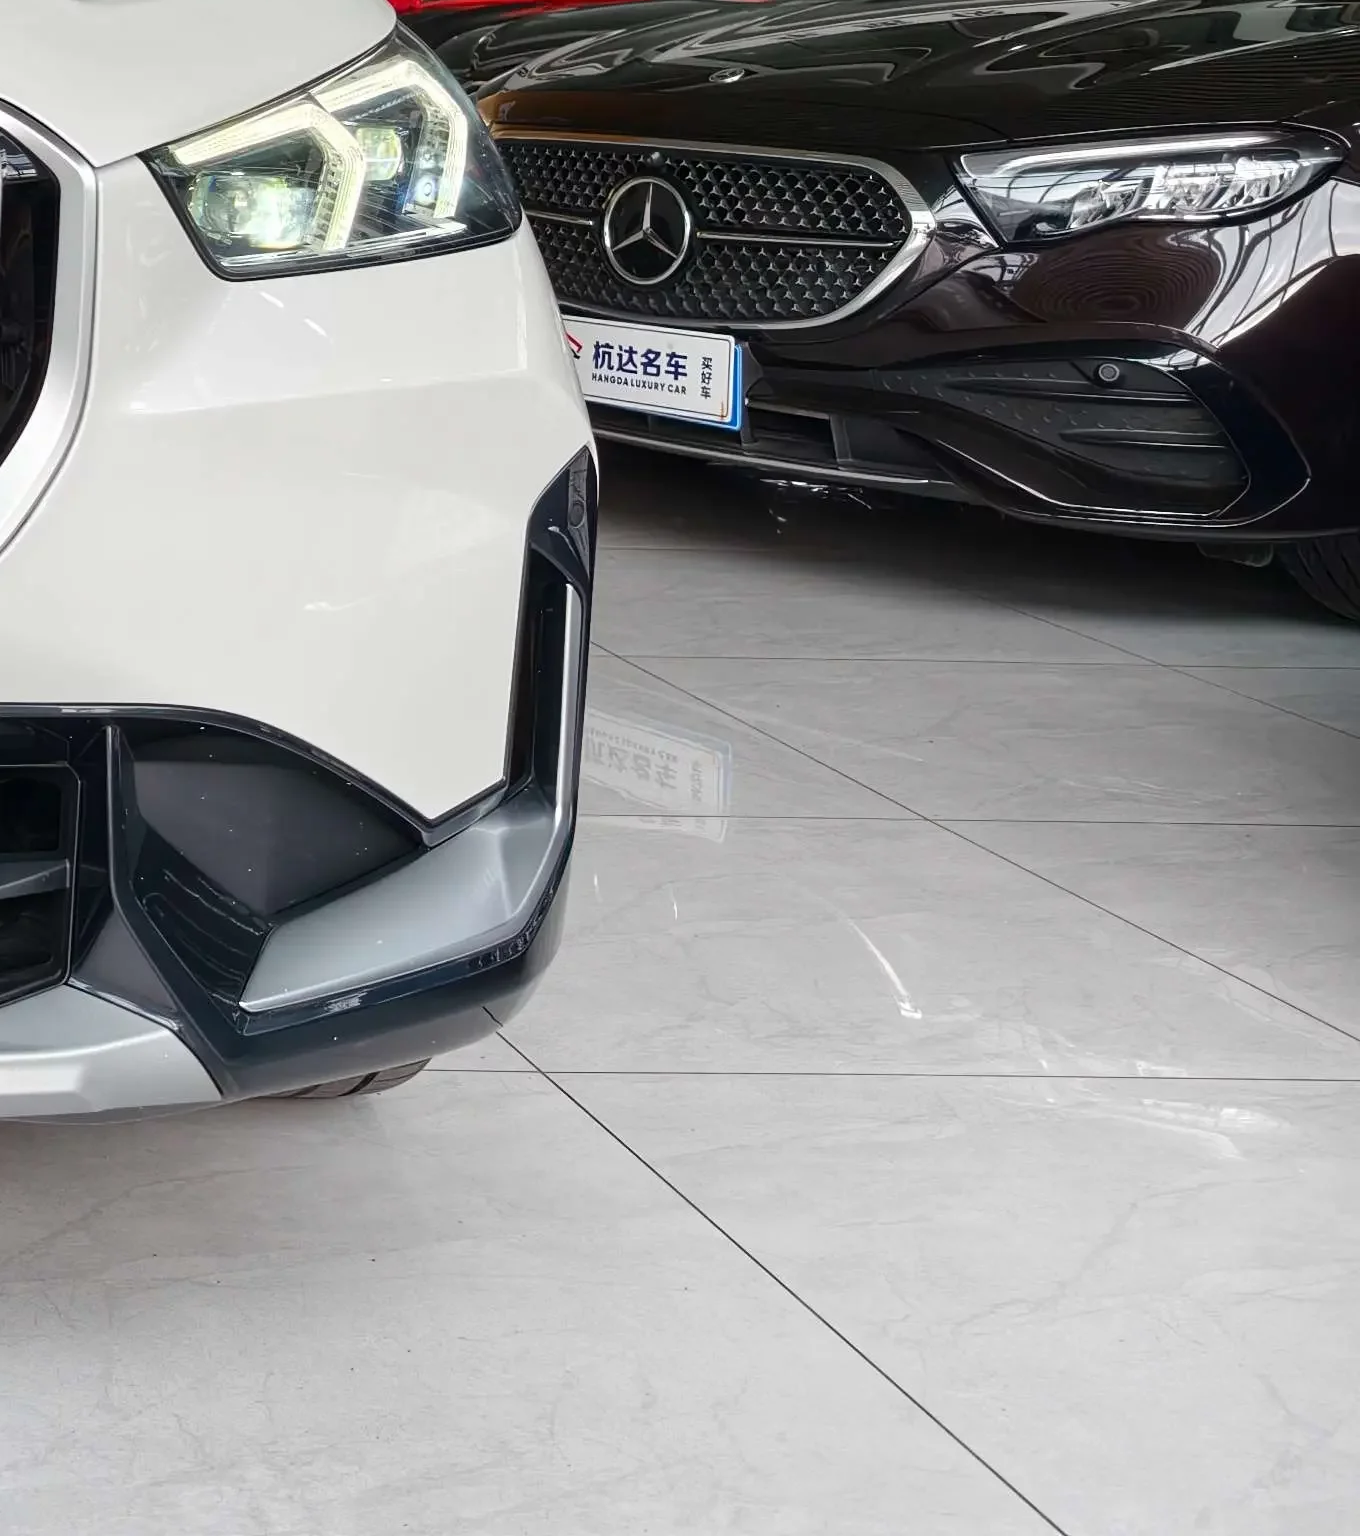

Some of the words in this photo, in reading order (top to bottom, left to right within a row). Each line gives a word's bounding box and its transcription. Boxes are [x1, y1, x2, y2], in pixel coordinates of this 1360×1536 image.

[592, 340, 688, 381] 杭达名车
[700, 356, 713, 400] 买好车
[592, 372, 628, 387] HANGDA
[630, 378, 665, 392] LUXURY
[667, 384, 687, 395] CAR
